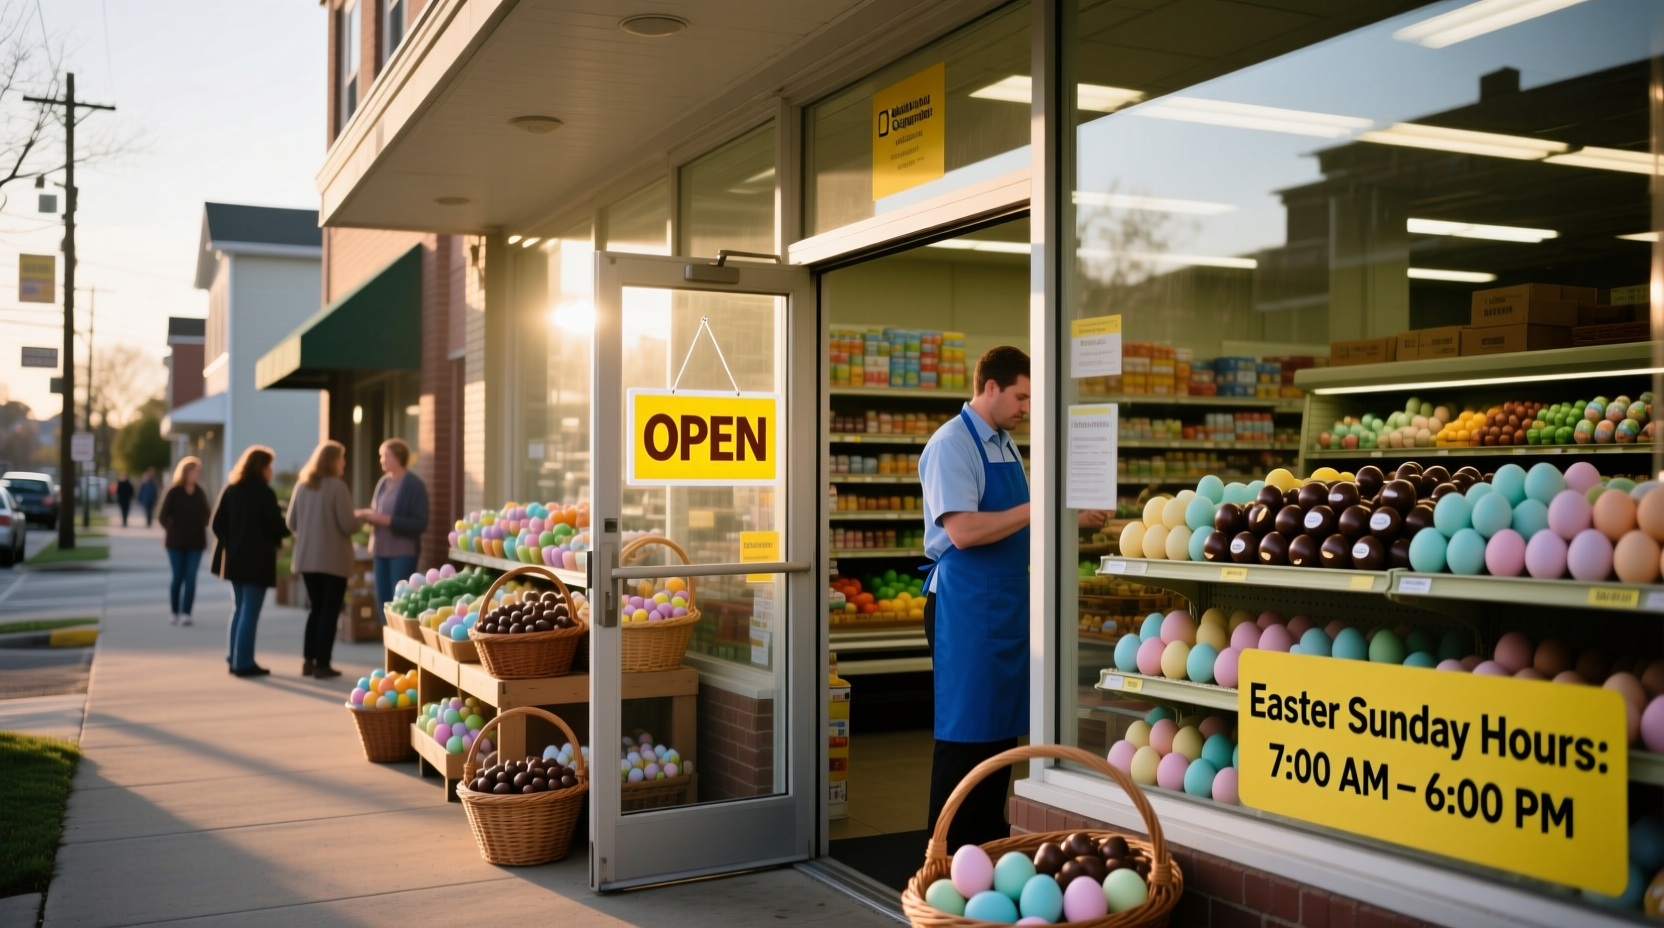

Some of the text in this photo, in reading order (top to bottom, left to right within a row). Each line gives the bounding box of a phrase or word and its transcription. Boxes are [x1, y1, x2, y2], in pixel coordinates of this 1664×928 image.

[643, 412, 767, 462] OPEN
[1250, 682, 1609, 774] Easter Sunday Hours:
[1268, 742, 1331, 788] 7:00
[1338, 757, 1389, 800] AM
[1425, 772, 1503, 824] 6:00
[1515, 788, 1574, 839] PM
